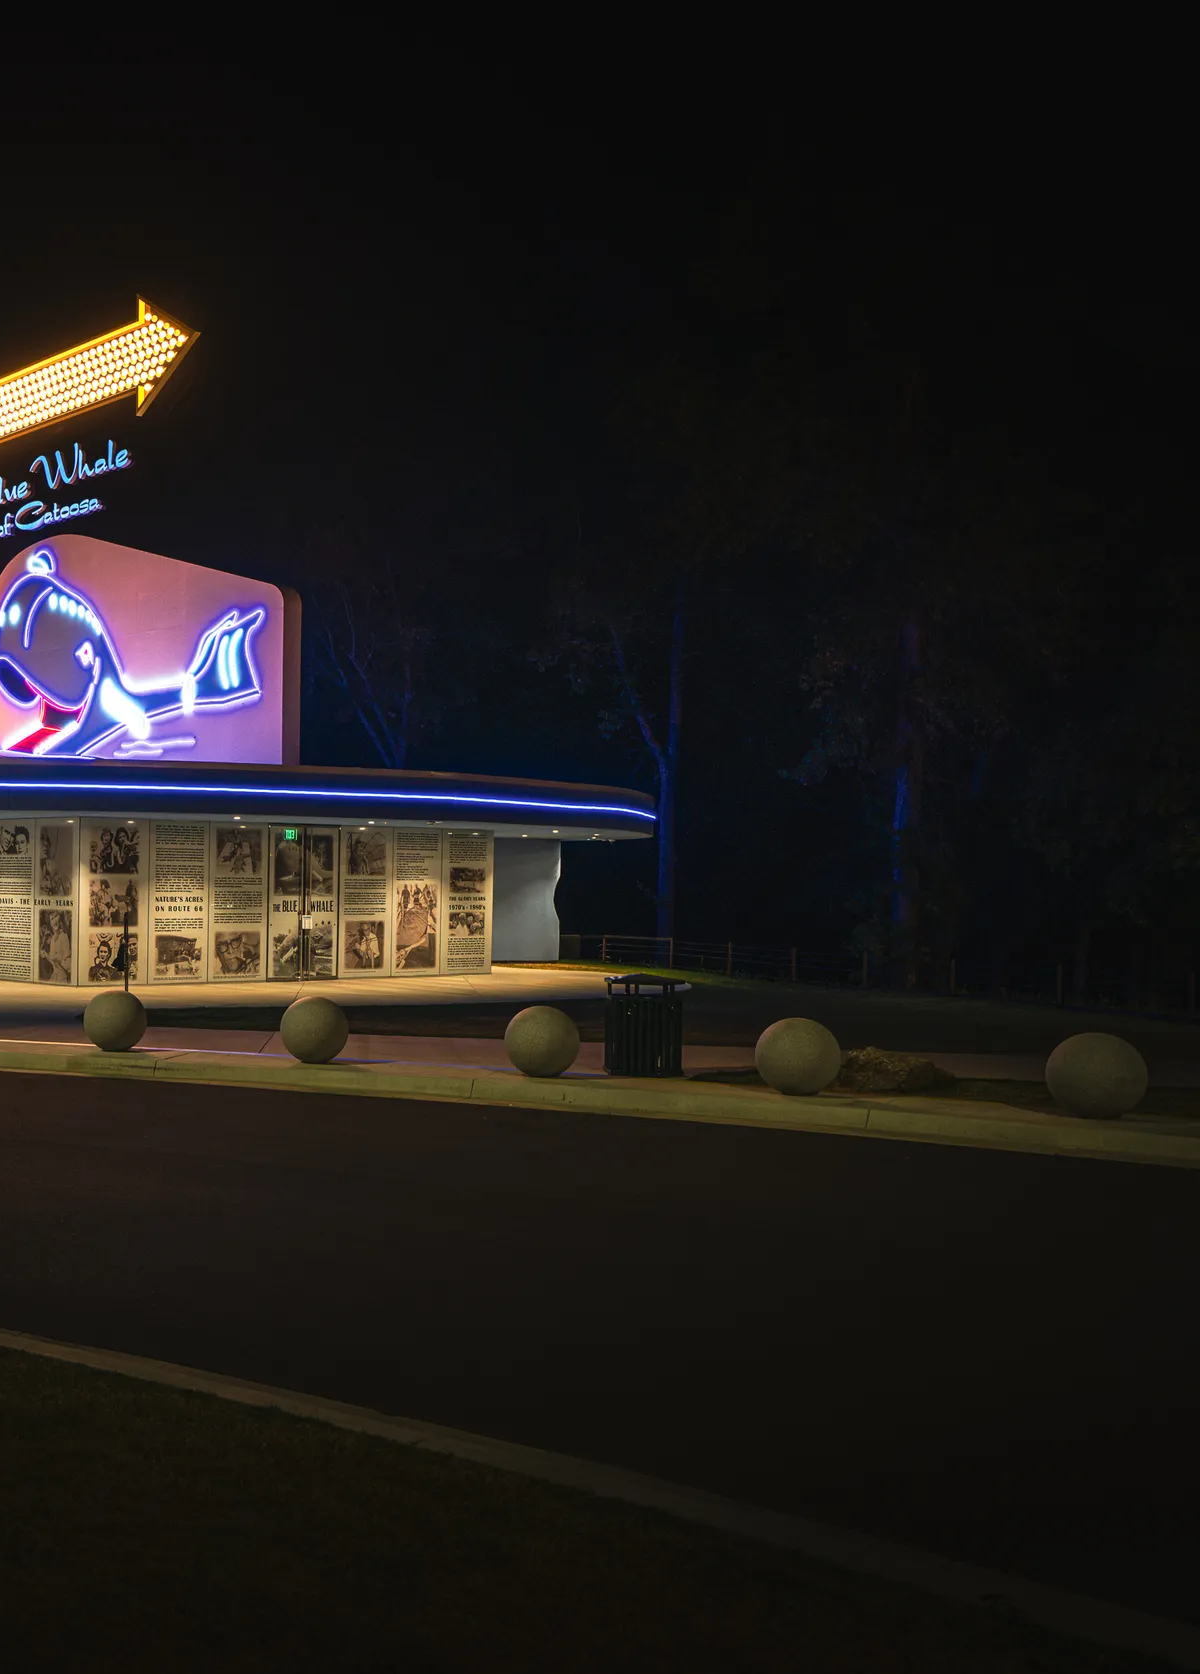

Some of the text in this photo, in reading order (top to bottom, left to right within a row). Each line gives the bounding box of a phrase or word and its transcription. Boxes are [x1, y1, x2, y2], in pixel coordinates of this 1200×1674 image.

[29, 439, 131, 489] Whale
[14, 498, 102, 530] Catoosa
[282, 900, 297, 912] BLUE
[310, 900, 334, 912] WHALE
